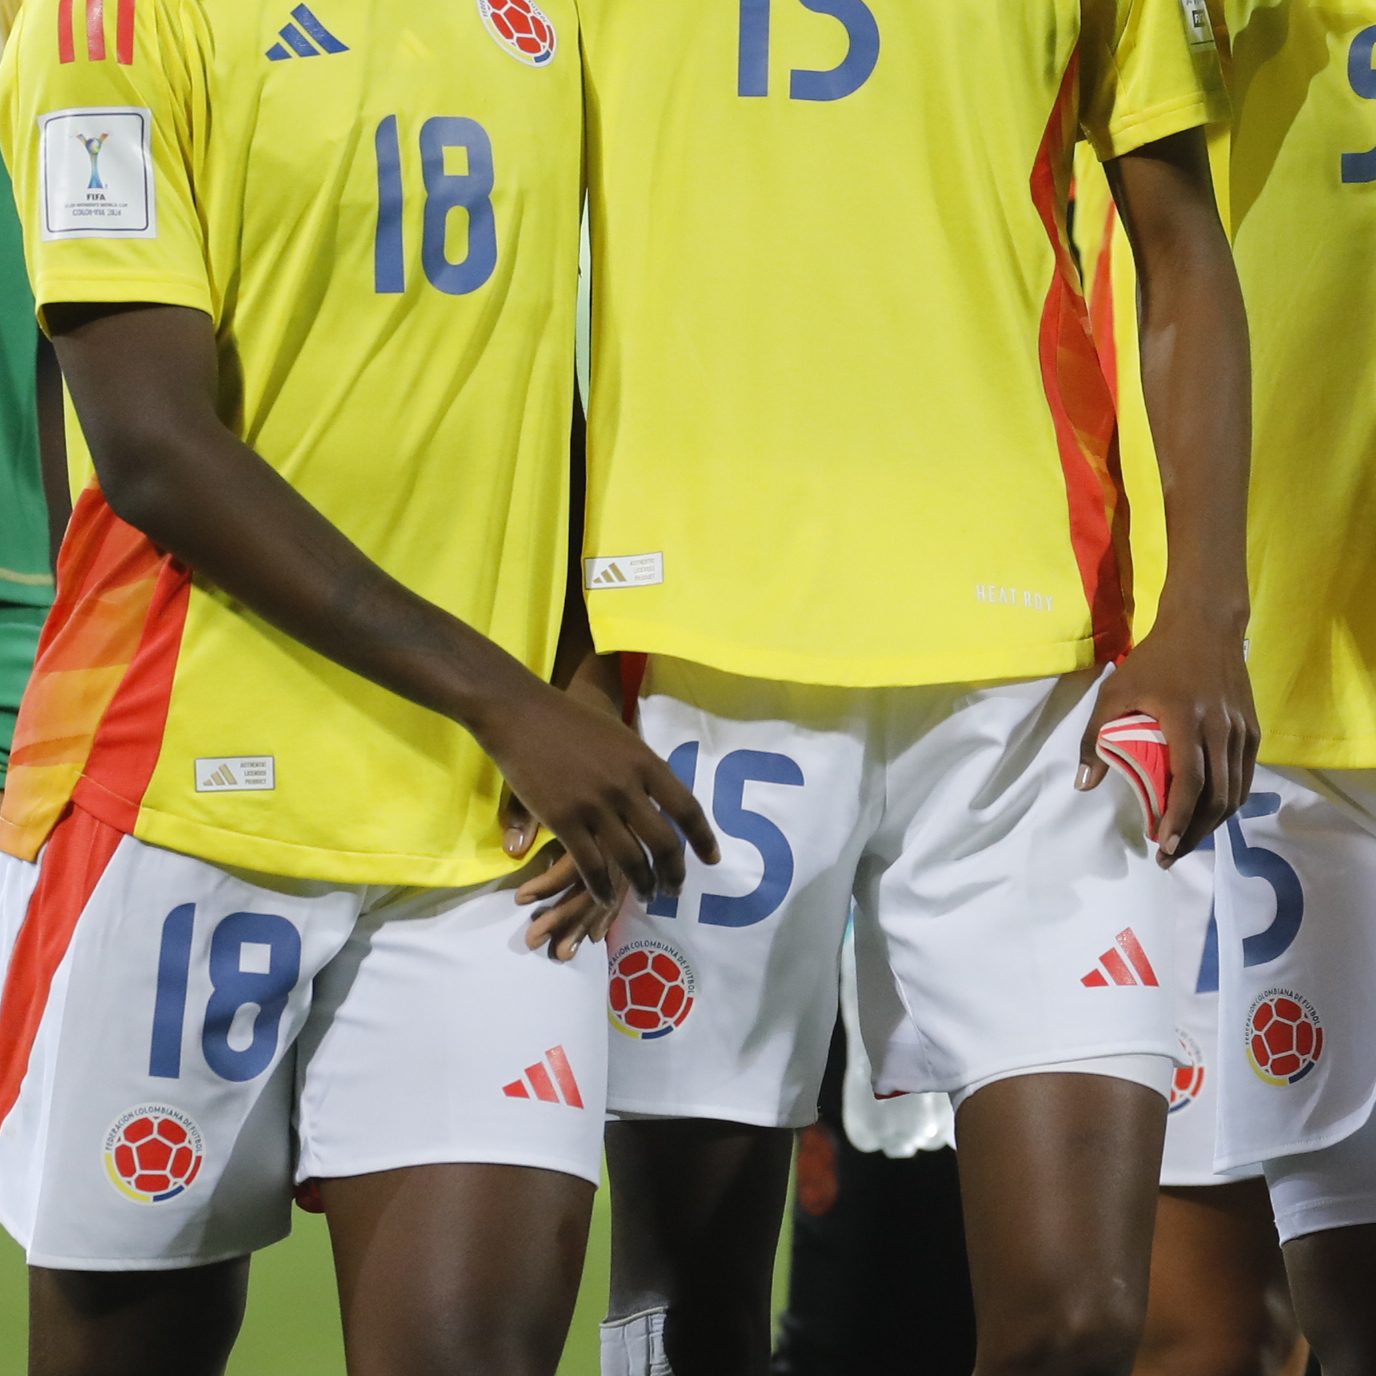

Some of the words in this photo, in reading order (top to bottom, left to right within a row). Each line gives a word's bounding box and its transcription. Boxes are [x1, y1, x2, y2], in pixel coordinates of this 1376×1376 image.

[86, 193, 106, 201] FIFA
[375, 114, 497, 295] 18
[646, 741, 805, 927] 15
[1227, 792, 1304, 968] 5
[149, 903, 302, 1082] 18
[630, 940, 680, 958] COLOMBIANA
[677, 955, 687, 966] DE
[683, 965, 695, 995] FUTBOL
[1256, 988, 1294, 1004] COLOMBIANA
[1293, 993, 1304, 1003] DE
[1301, 999, 1321, 1026] FUTBOL
[105, 1112, 134, 1152] FEDERACION
[134, 1106, 183, 1122] COLOMBIANA
[182, 1118, 193, 1128] DE
[189, 1126, 203, 1153] FUTBOL
